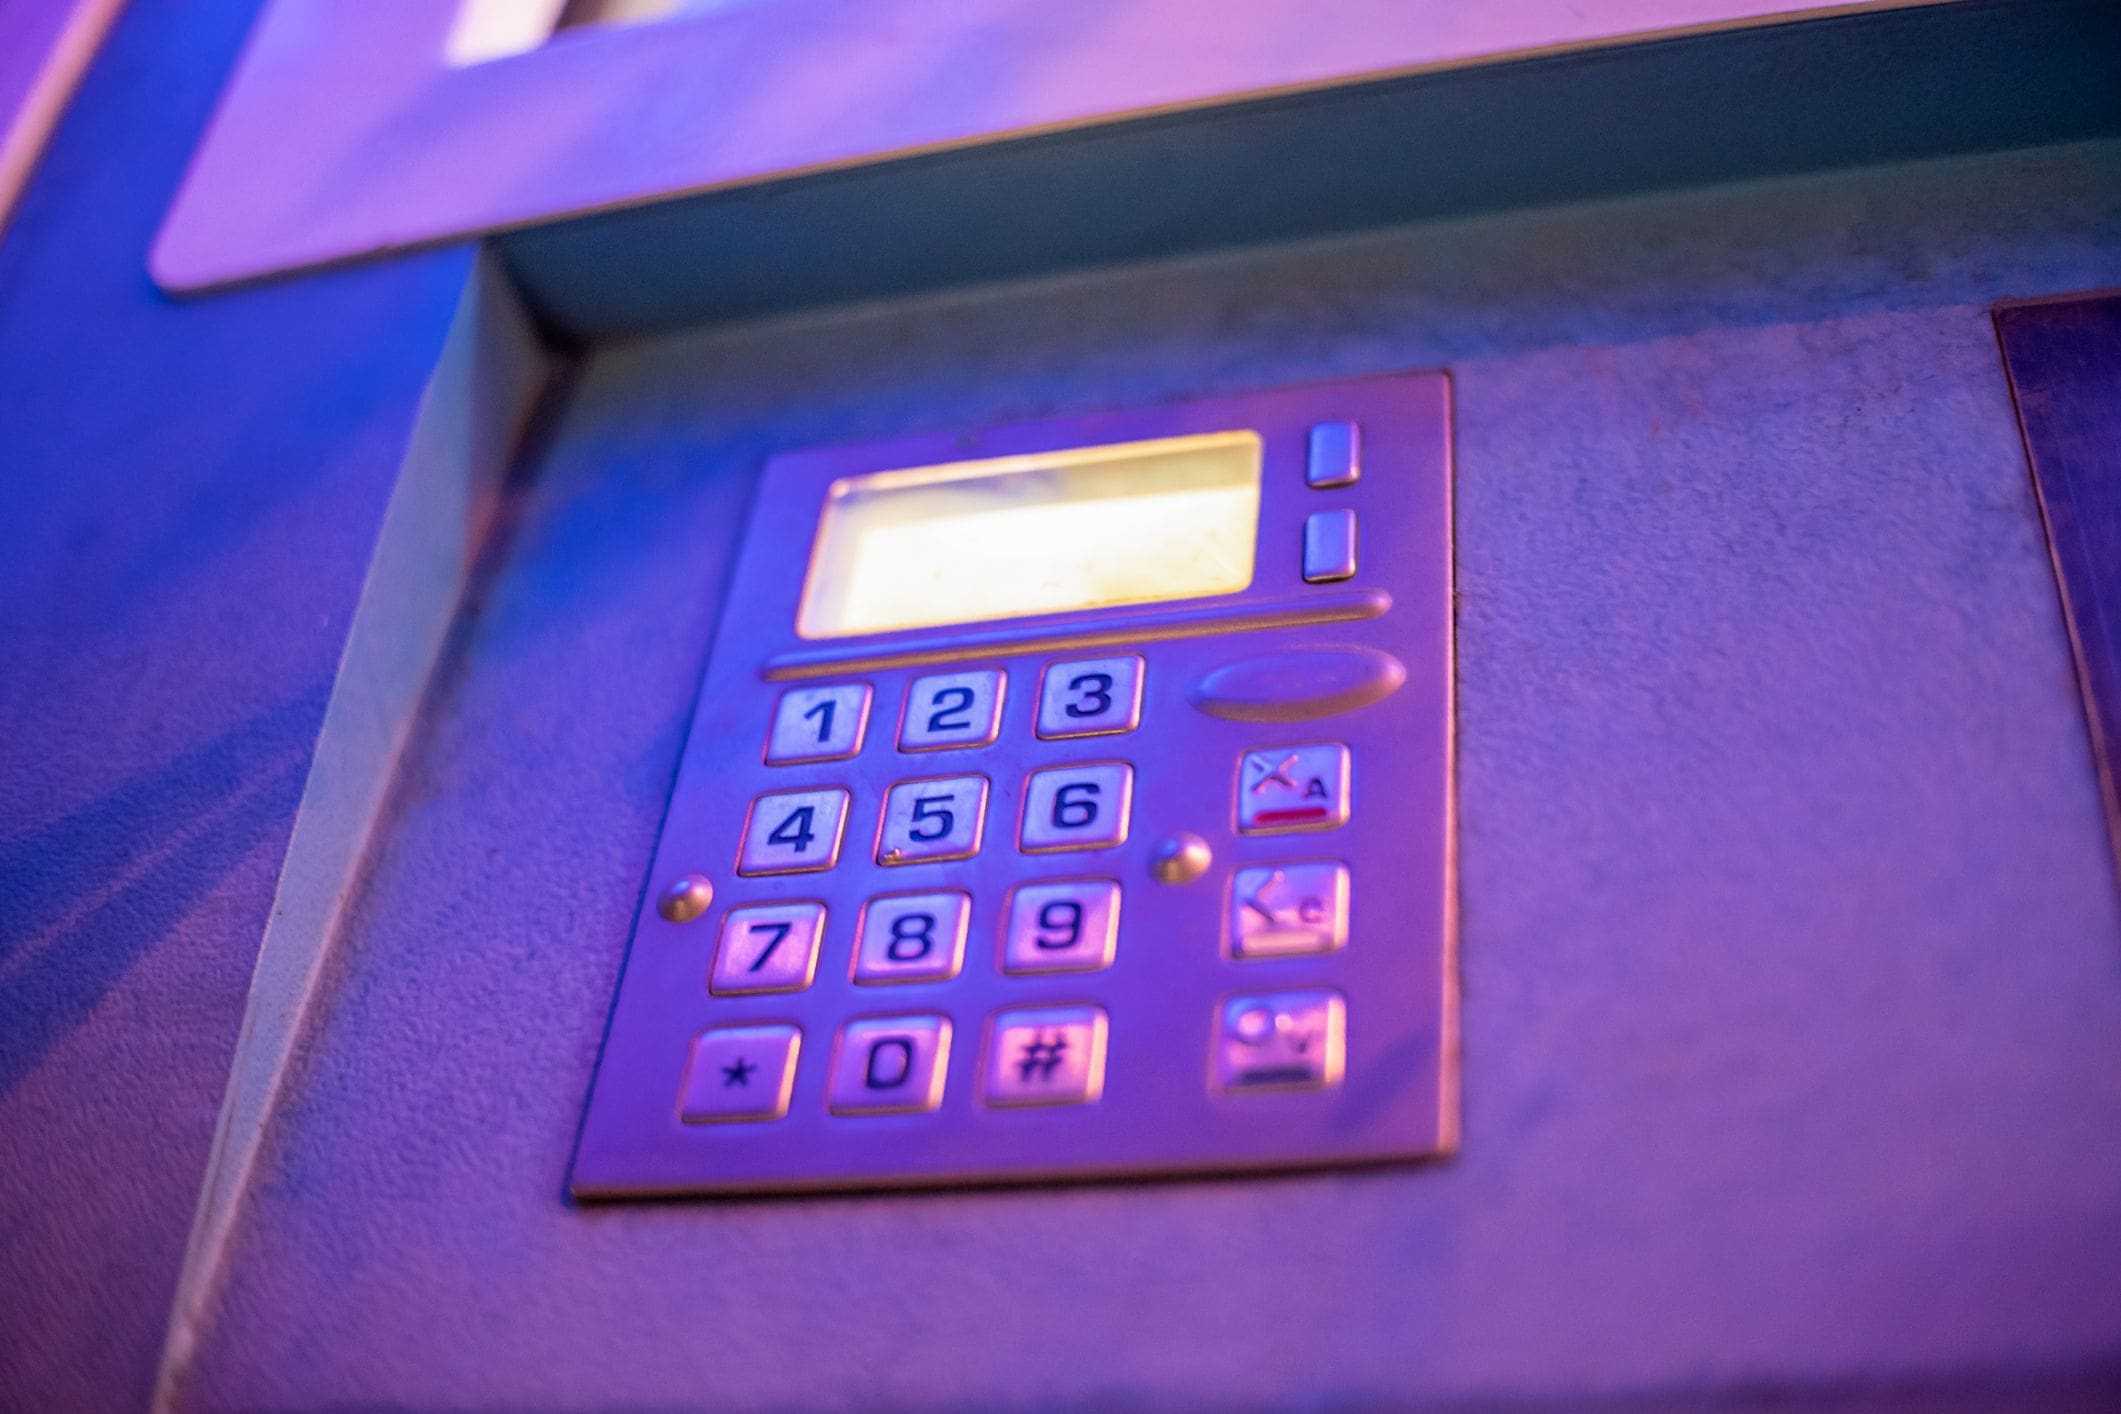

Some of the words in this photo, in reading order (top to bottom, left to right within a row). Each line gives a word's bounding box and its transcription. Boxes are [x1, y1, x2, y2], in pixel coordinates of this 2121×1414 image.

[927, 687, 974, 733] 2
[1065, 673, 1112, 718] 3
[803, 699, 837, 743] 1
[909, 794, 954, 841] 5
[1053, 783, 1099, 828] 6
[768, 806, 815, 853] 4
[748, 922, 792, 971] 7
[888, 913, 935, 962] 8
[1036, 901, 1085, 950] 9
[1017, 1032, 1068, 1082] #
